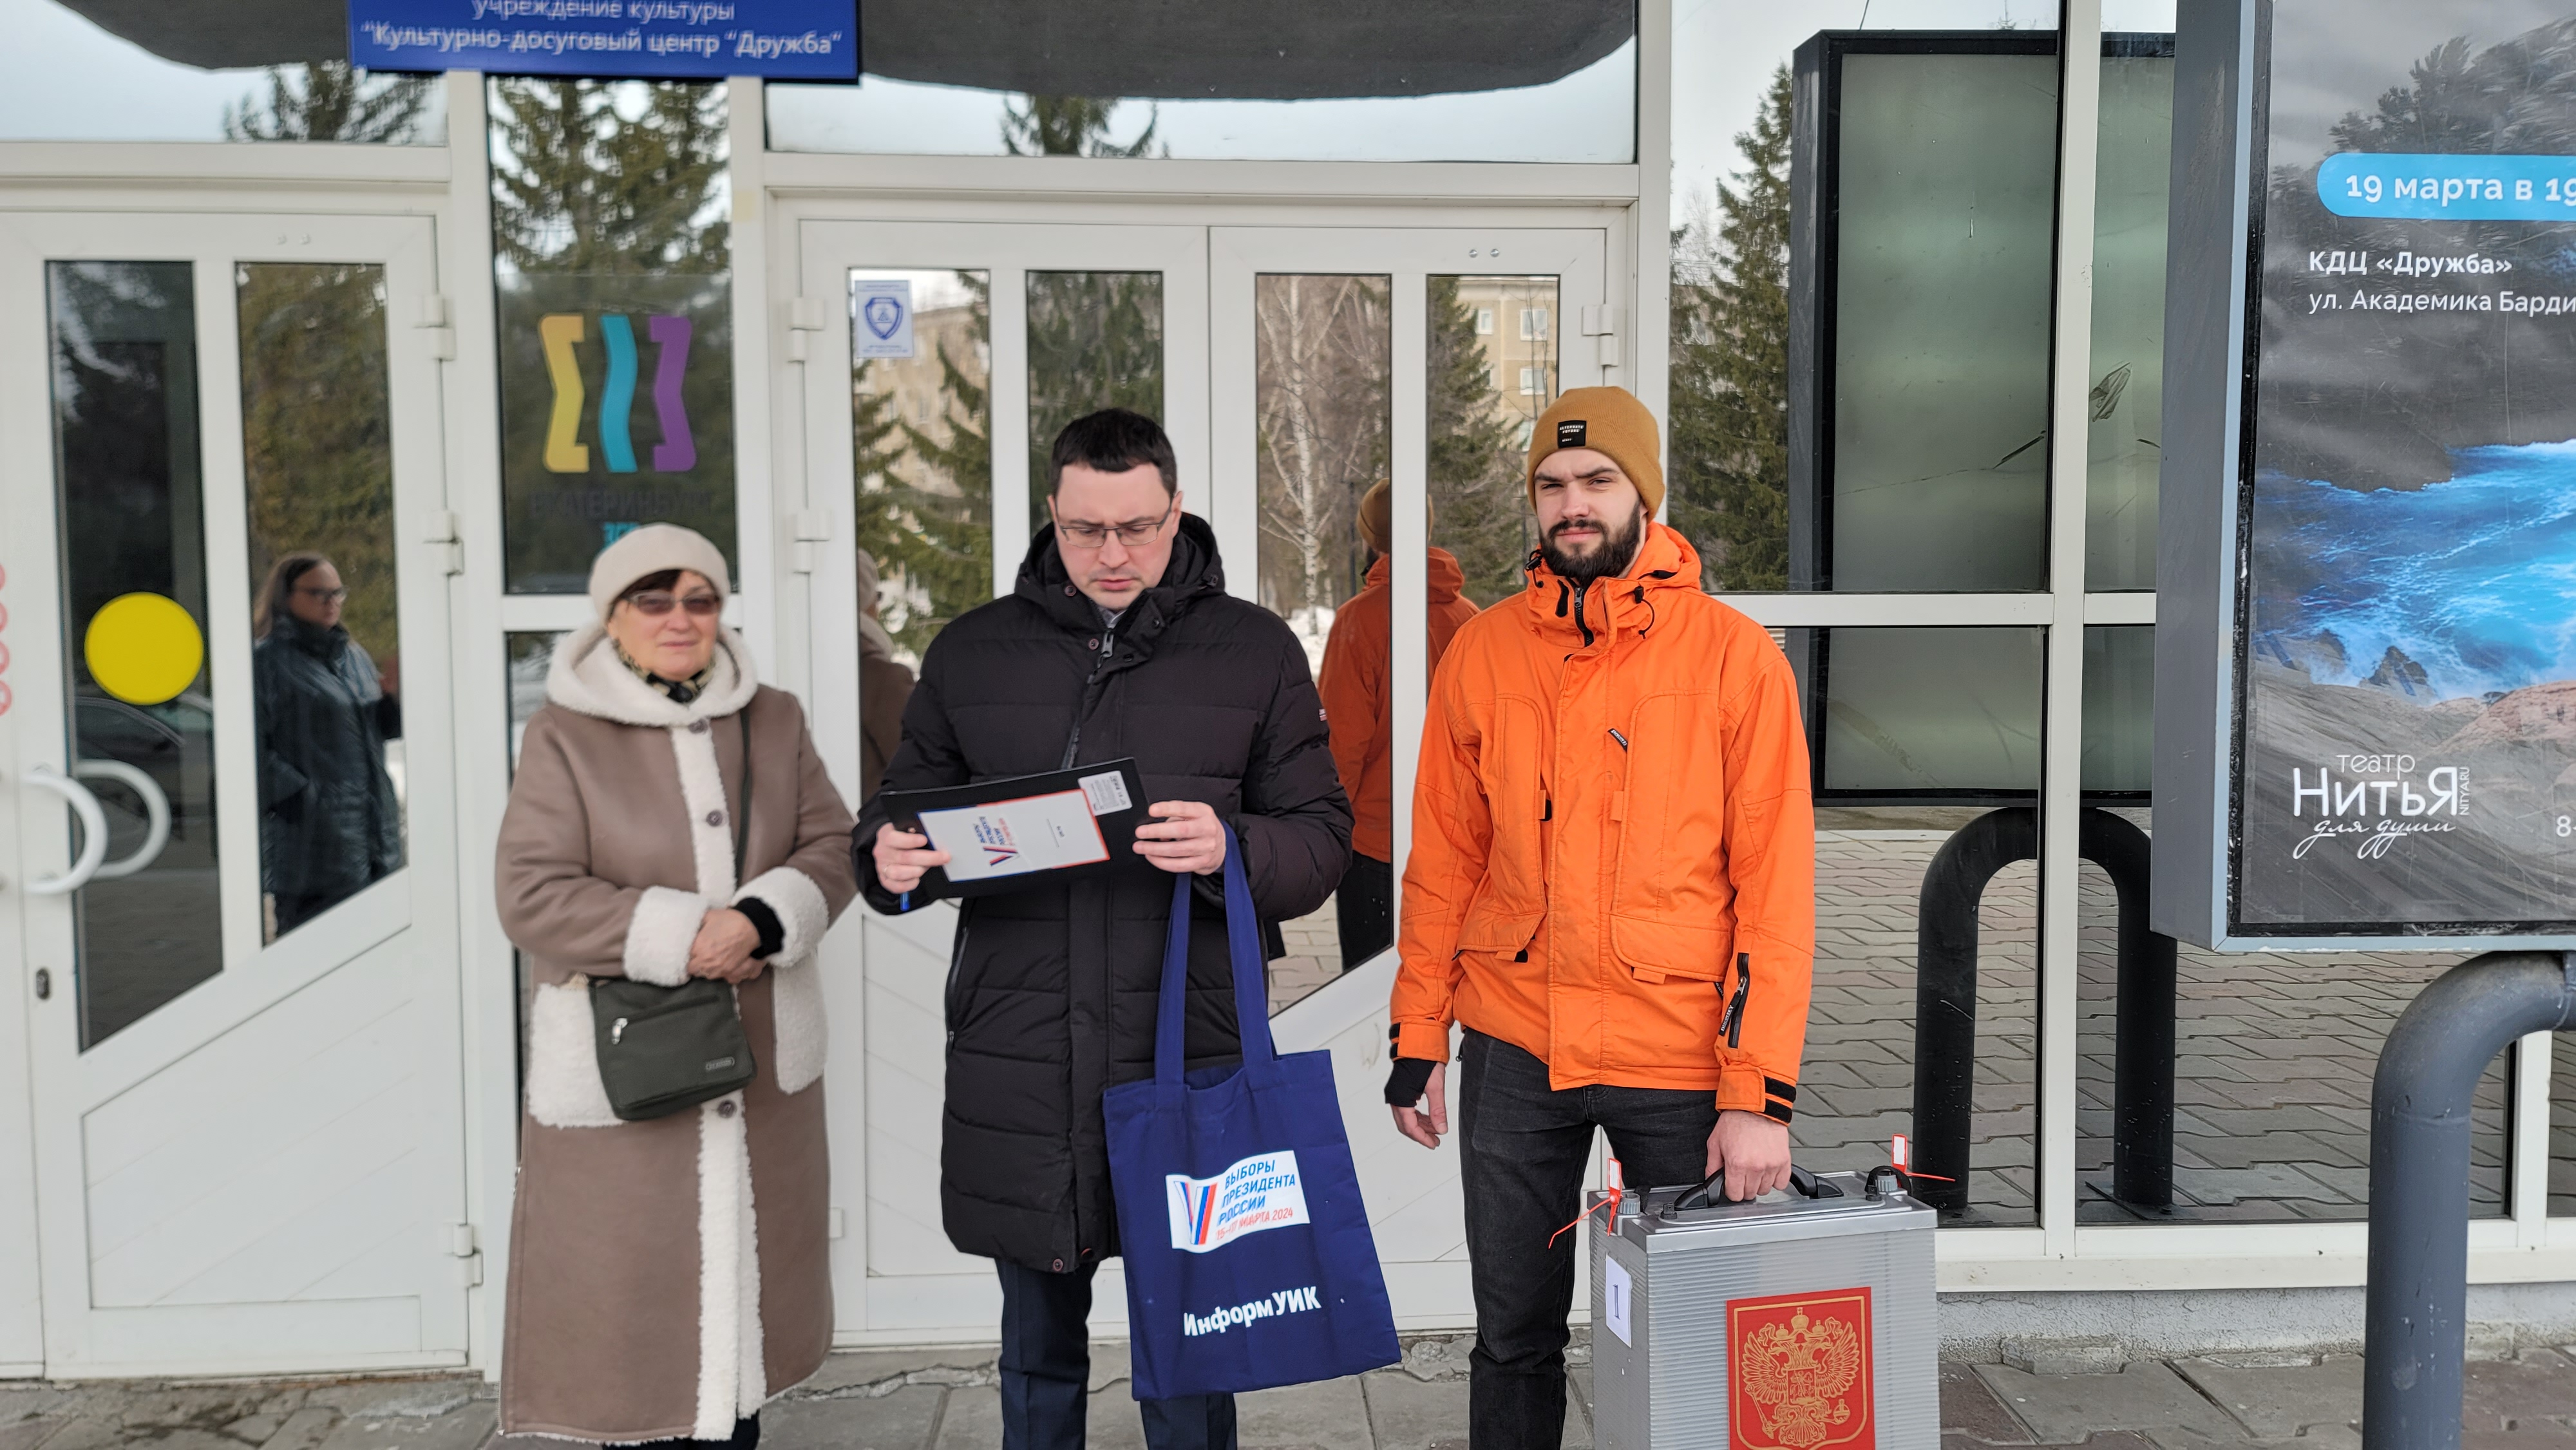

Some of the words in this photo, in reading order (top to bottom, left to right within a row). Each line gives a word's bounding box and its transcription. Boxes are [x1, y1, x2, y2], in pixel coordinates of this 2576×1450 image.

[472, 0, 622, 21] учреждение
[628, 1, 734, 25] культуры
[647, 33, 720, 58] центр
[2346, 174, 2382, 203] 19
[2394, 178, 2503, 207] марта
[2515, 179, 2533, 200] в
[2309, 251, 2367, 276] КДЦ
[2376, 251, 2512, 278] «Дружба»
[2309, 293, 2342, 314] ул.
[2350, 289, 2492, 314] Академика
[2336, 754, 2415, 780] театр
[2292, 820, 2370, 859] для
[2356, 819, 2456, 859] души
[1225, 1160, 1275, 1191] ВЫБОРЫ
[1222, 1174, 1296, 1209] ПРЕЗИДЕНТА
[1217, 1195, 1266, 1226] РОССИИ
[1238, 1211, 1270, 1230] МАРТА
[1272, 1207, 1294, 1221] 2024
